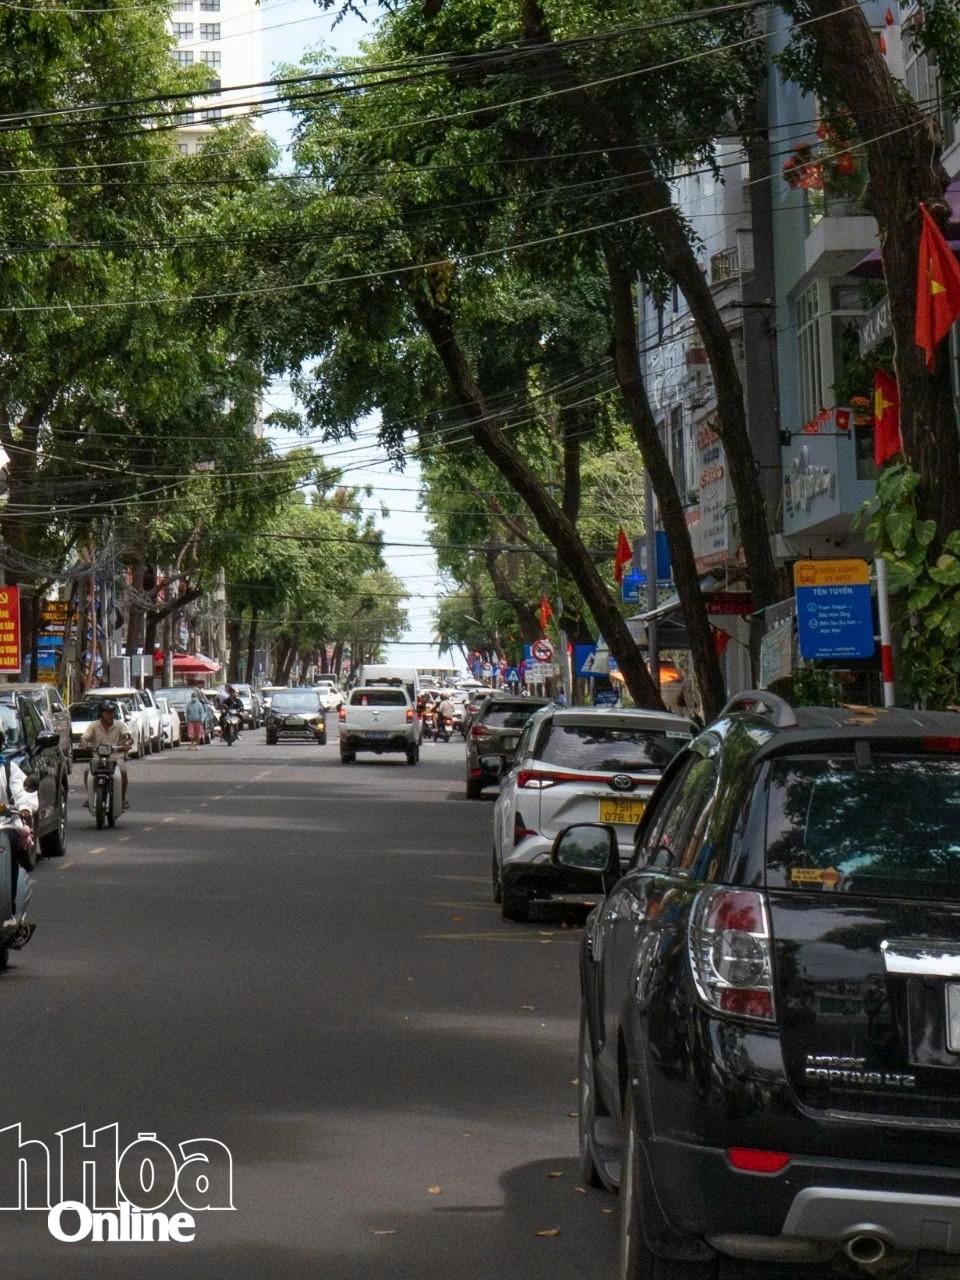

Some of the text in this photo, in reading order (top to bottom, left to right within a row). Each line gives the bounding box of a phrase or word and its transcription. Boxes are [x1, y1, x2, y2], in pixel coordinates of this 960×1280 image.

[813, 585, 853, 596] TÊN TUYẾN
[3, 633, 15, 642] NAM
[805, 1067, 916, 1086] CAPTIVA LTZ
